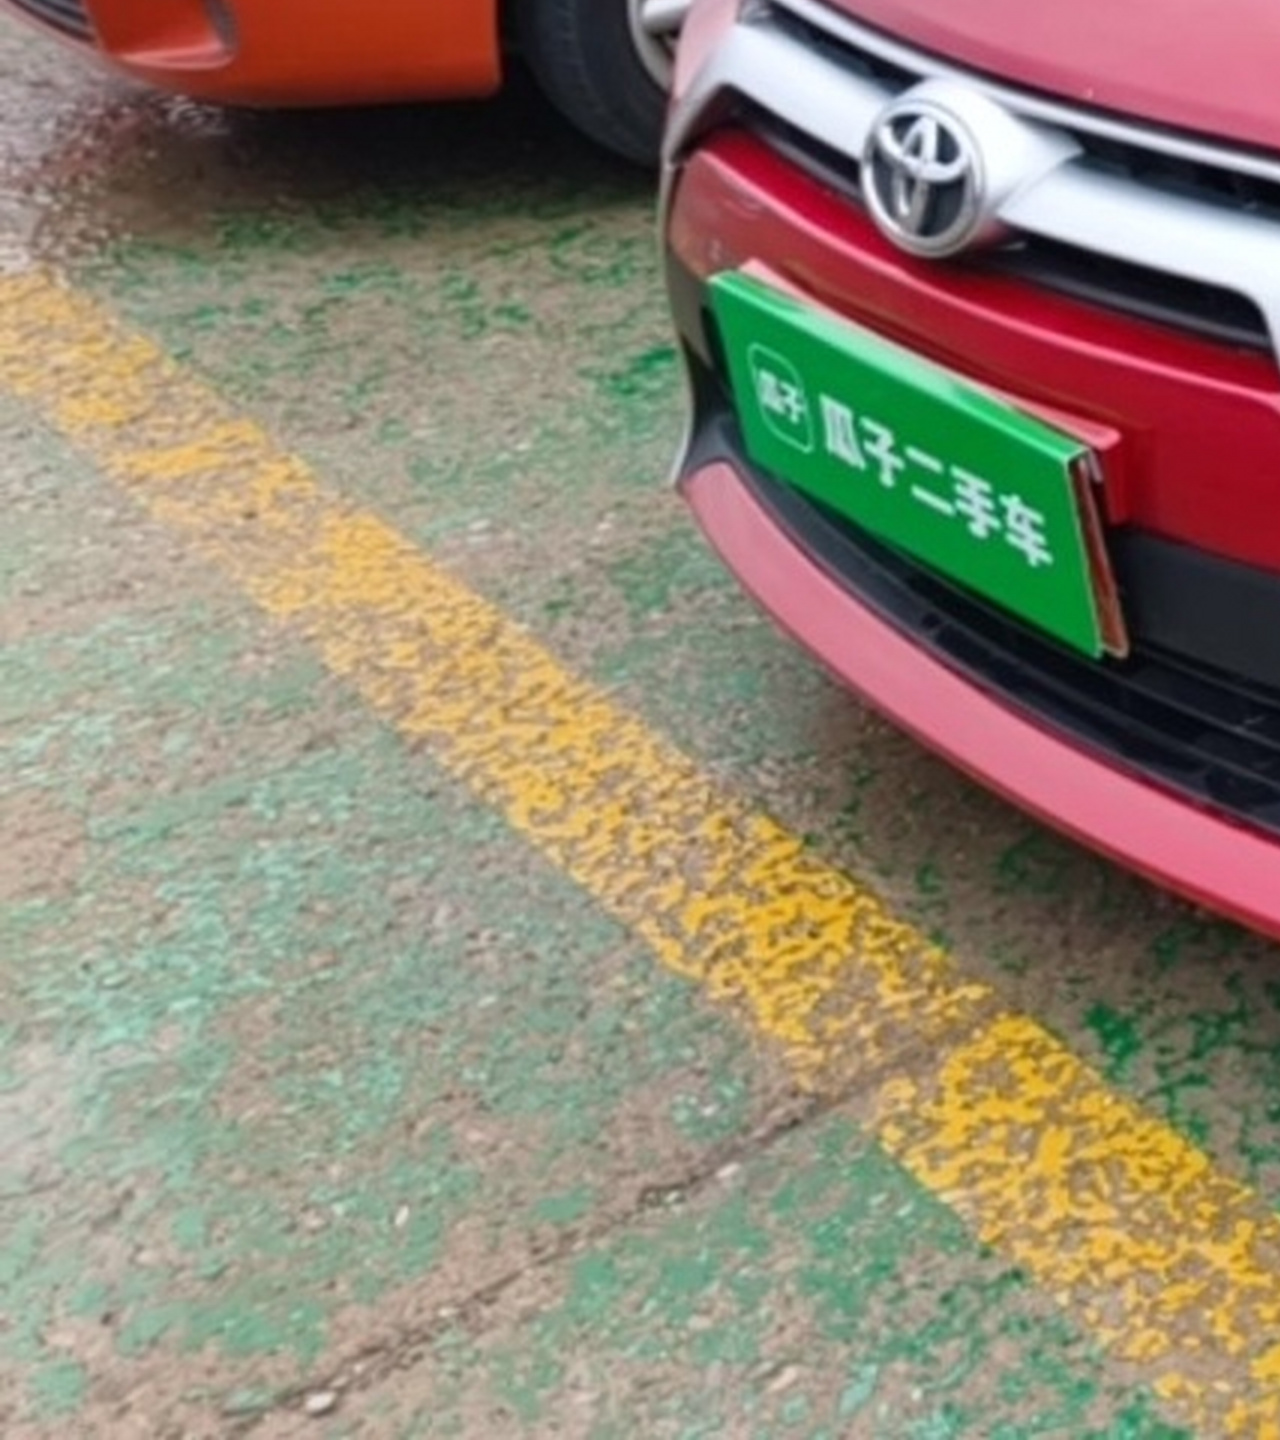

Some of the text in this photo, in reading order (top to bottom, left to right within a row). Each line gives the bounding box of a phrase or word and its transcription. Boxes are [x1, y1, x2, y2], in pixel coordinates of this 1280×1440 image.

[819, 392, 1054, 568] 瓜子二手车
